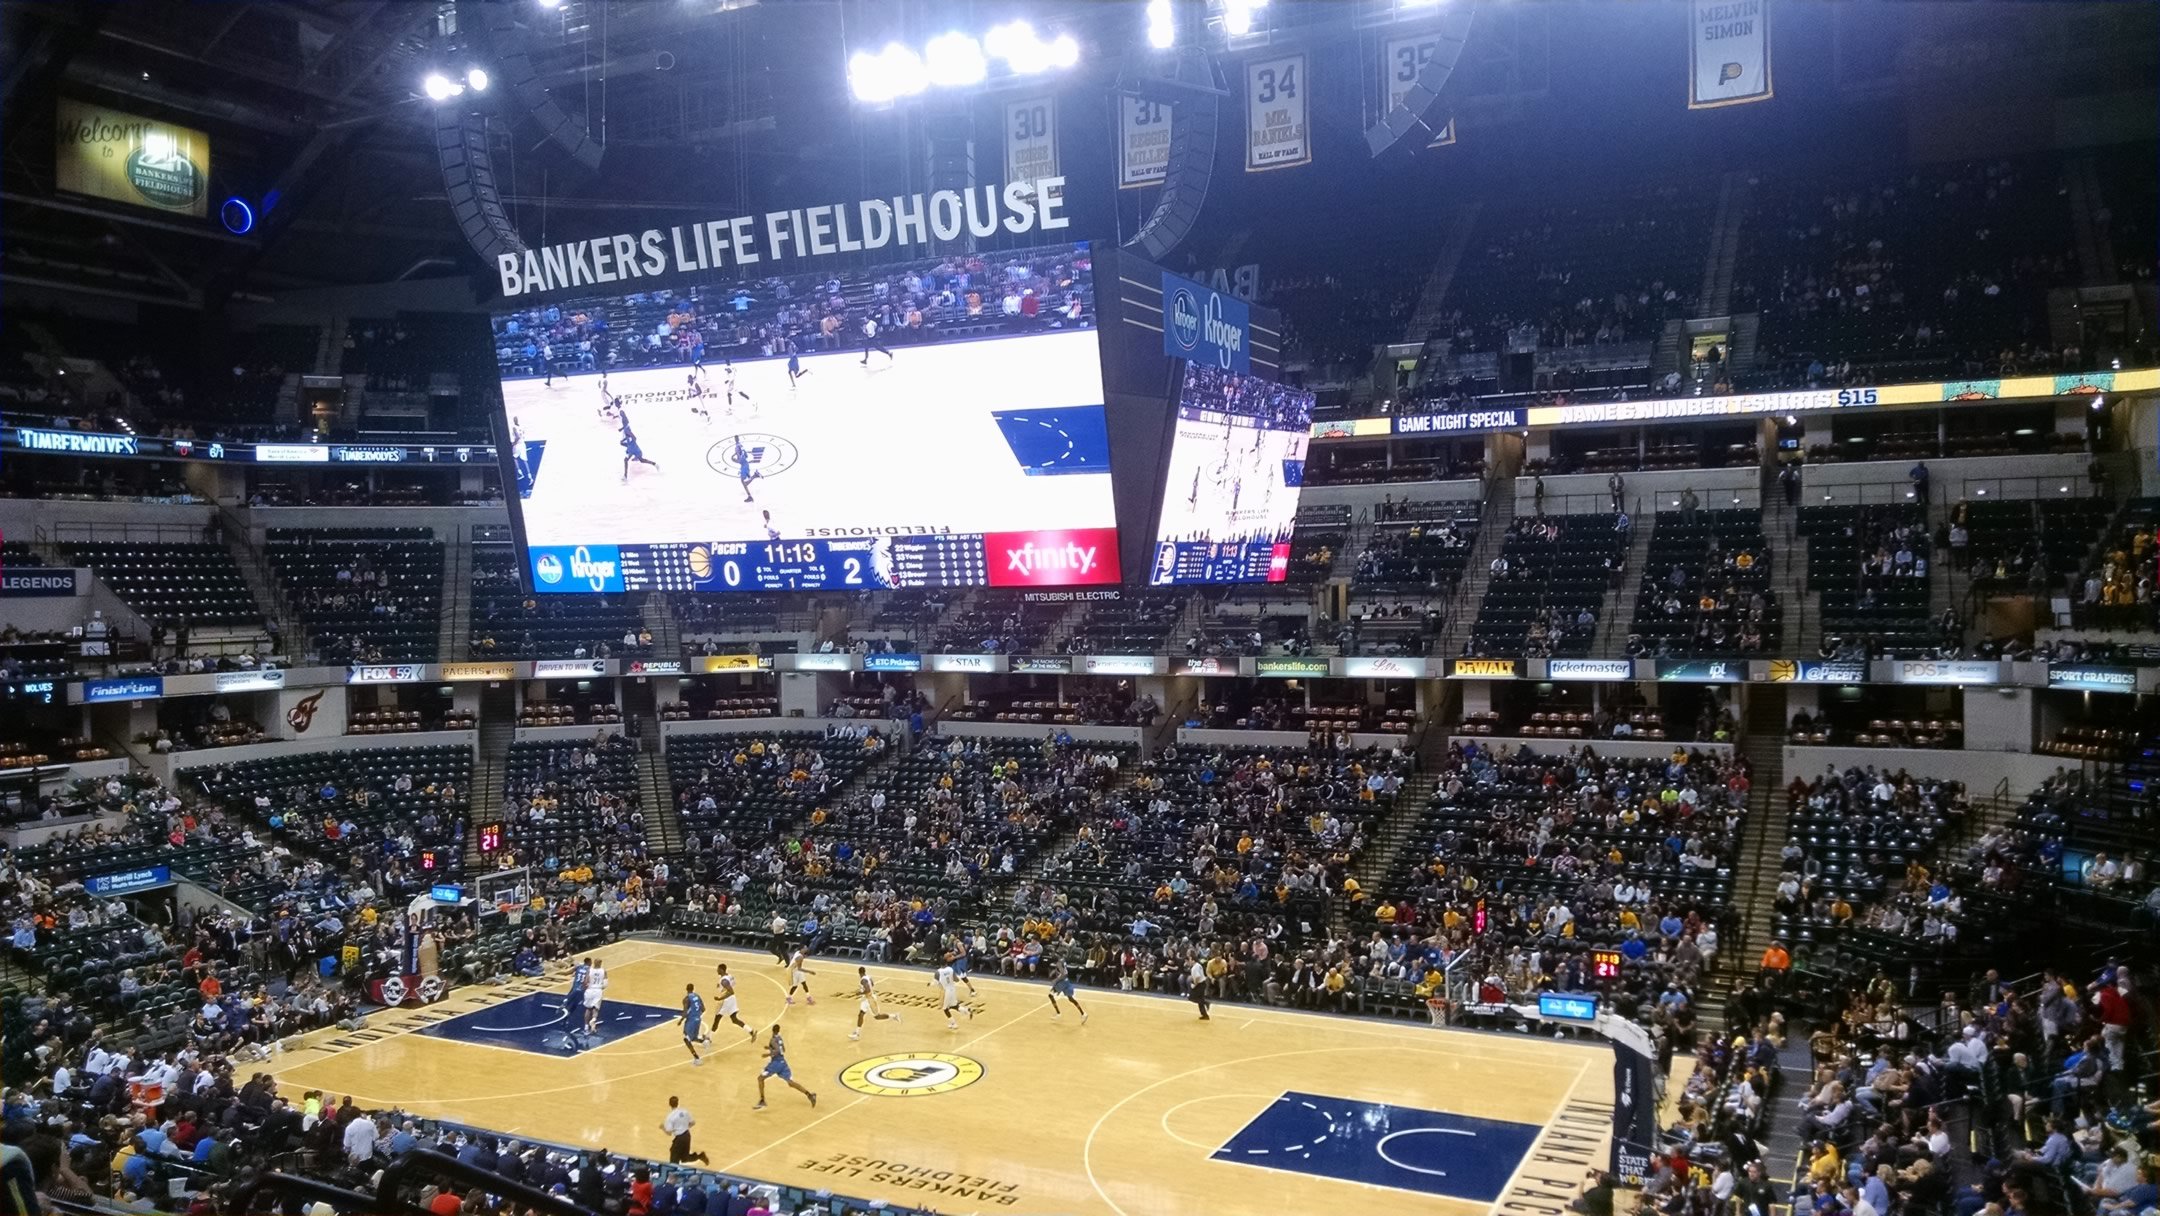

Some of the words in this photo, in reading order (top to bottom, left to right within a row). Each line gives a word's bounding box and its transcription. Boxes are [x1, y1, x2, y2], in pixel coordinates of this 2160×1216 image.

[1700, 0, 1758, 23] MELVIN
[1705, 20, 1753, 41] SIMON
[1258, 65, 1296, 104] 34
[1135, 100, 1163, 126] 31
[1265, 109, 1292, 126] MEL
[59, 116, 154, 145] Welcome
[1015, 105, 1047, 141] 30
[1253, 124, 1304, 147] DANIELS
[102, 145, 114, 158] to
[1127, 149, 1169, 166] MILLE
[1258, 150, 1274, 160] HALL
[1274, 149, 1282, 158] OF
[1281, 148, 1299, 157] FAME
[135, 167, 178, 182] BANKERS
[135, 178, 195, 196] FIELDHOUSE
[498, 229, 668, 297] BANKERS
[673, 215, 761, 273] LIFE
[764, 176, 1070, 260] FIELDHOUSE
[1174, 296, 1198, 341] Kroger
[1204, 291, 1242, 370] Kroger
[1561, 404, 1617, 424] NAME
[1641, 398, 1728, 418] NUMBER
[1728, 392, 1833, 413] T-SHIRTS
[1838, 389, 1877, 407] $15
[1398, 416, 1430, 433] GAME
[1432, 414, 1469, 431] NIGHT
[1469, 410, 1518, 429] SPECIAL
[180, 447, 187, 456] 0
[209, 448, 224, 459] 6/1
[339, 450, 400, 462] TIMBERWOLVES
[428, 452, 433, 462] 1
[459, 452, 468, 462] 0
[805, 526, 950, 537] FIELDHOUSE
[711, 541, 748, 556] Pacers
[764, 542, 816, 564] 11:13
[1221, 545, 1239, 558] 11:13
[569, 545, 616, 592] Kroger
[723, 560, 741, 588] 0
[756, 566, 762, 574] 6
[819, 564, 825, 573] 6
[843, 557, 863, 585] 2
[1205, 564, 1212, 579] 0
[1238, 564, 1245, 579] 2
[2, 576, 73, 589] LEGENDS
[757, 574, 763, 582] 0
[788, 577, 796, 589] 1
[820, 573, 827, 581] 0
[1024, 592, 1074, 602] MITSUBISHI
[1075, 591, 1121, 601] ELECTRIC
[538, 664, 562, 673] DRIVEN
[564, 664, 573, 672] TO
[573, 663, 589, 672] WIN
[642, 661, 681, 669] REPUBLIC
[758, 657, 773, 667] CAT
[874, 658, 890, 667] ETC
[956, 658, 982, 667] STAR
[1187, 658, 1202, 667] the
[1257, 661, 1328, 671] bankerslife.com
[1551, 661, 1630, 676] ticketmaster
[361, 666, 394, 681] FOX
[396, 666, 412, 680] 59
[1805, 666, 1864, 681] @Pacers
[1902, 664, 1936, 676] PDS
[2049, 669, 2082, 682] SPORT
[2082, 670, 2136, 685] GRAPHICS
[25, 683, 54, 693] WOLVES
[91, 685, 127, 697] Finish
[132, 684, 157, 693] Line
[45, 694, 52, 703] 2
[482, 834, 498, 851] 21
[424, 859, 433, 869] 21
[111, 872, 133, 883] Merrill
[133, 870, 153, 880] Lynch
[1595, 953, 1620, 965] 11:13
[1598, 962, 1616, 977] 21
[311, 1008, 466, 1053] INDIANA
[1533, 1098, 1615, 1166] INDIANA
[1618, 1144, 1627, 1154] A
[1618, 1154, 1649, 1167] STATE
[797, 1159, 864, 1178] LIFE
[828, 1153, 1019, 1194] FIELDHOUSE
[1618, 1163, 1645, 1176] THAT
[869, 1171, 1020, 1206] BANKERS
